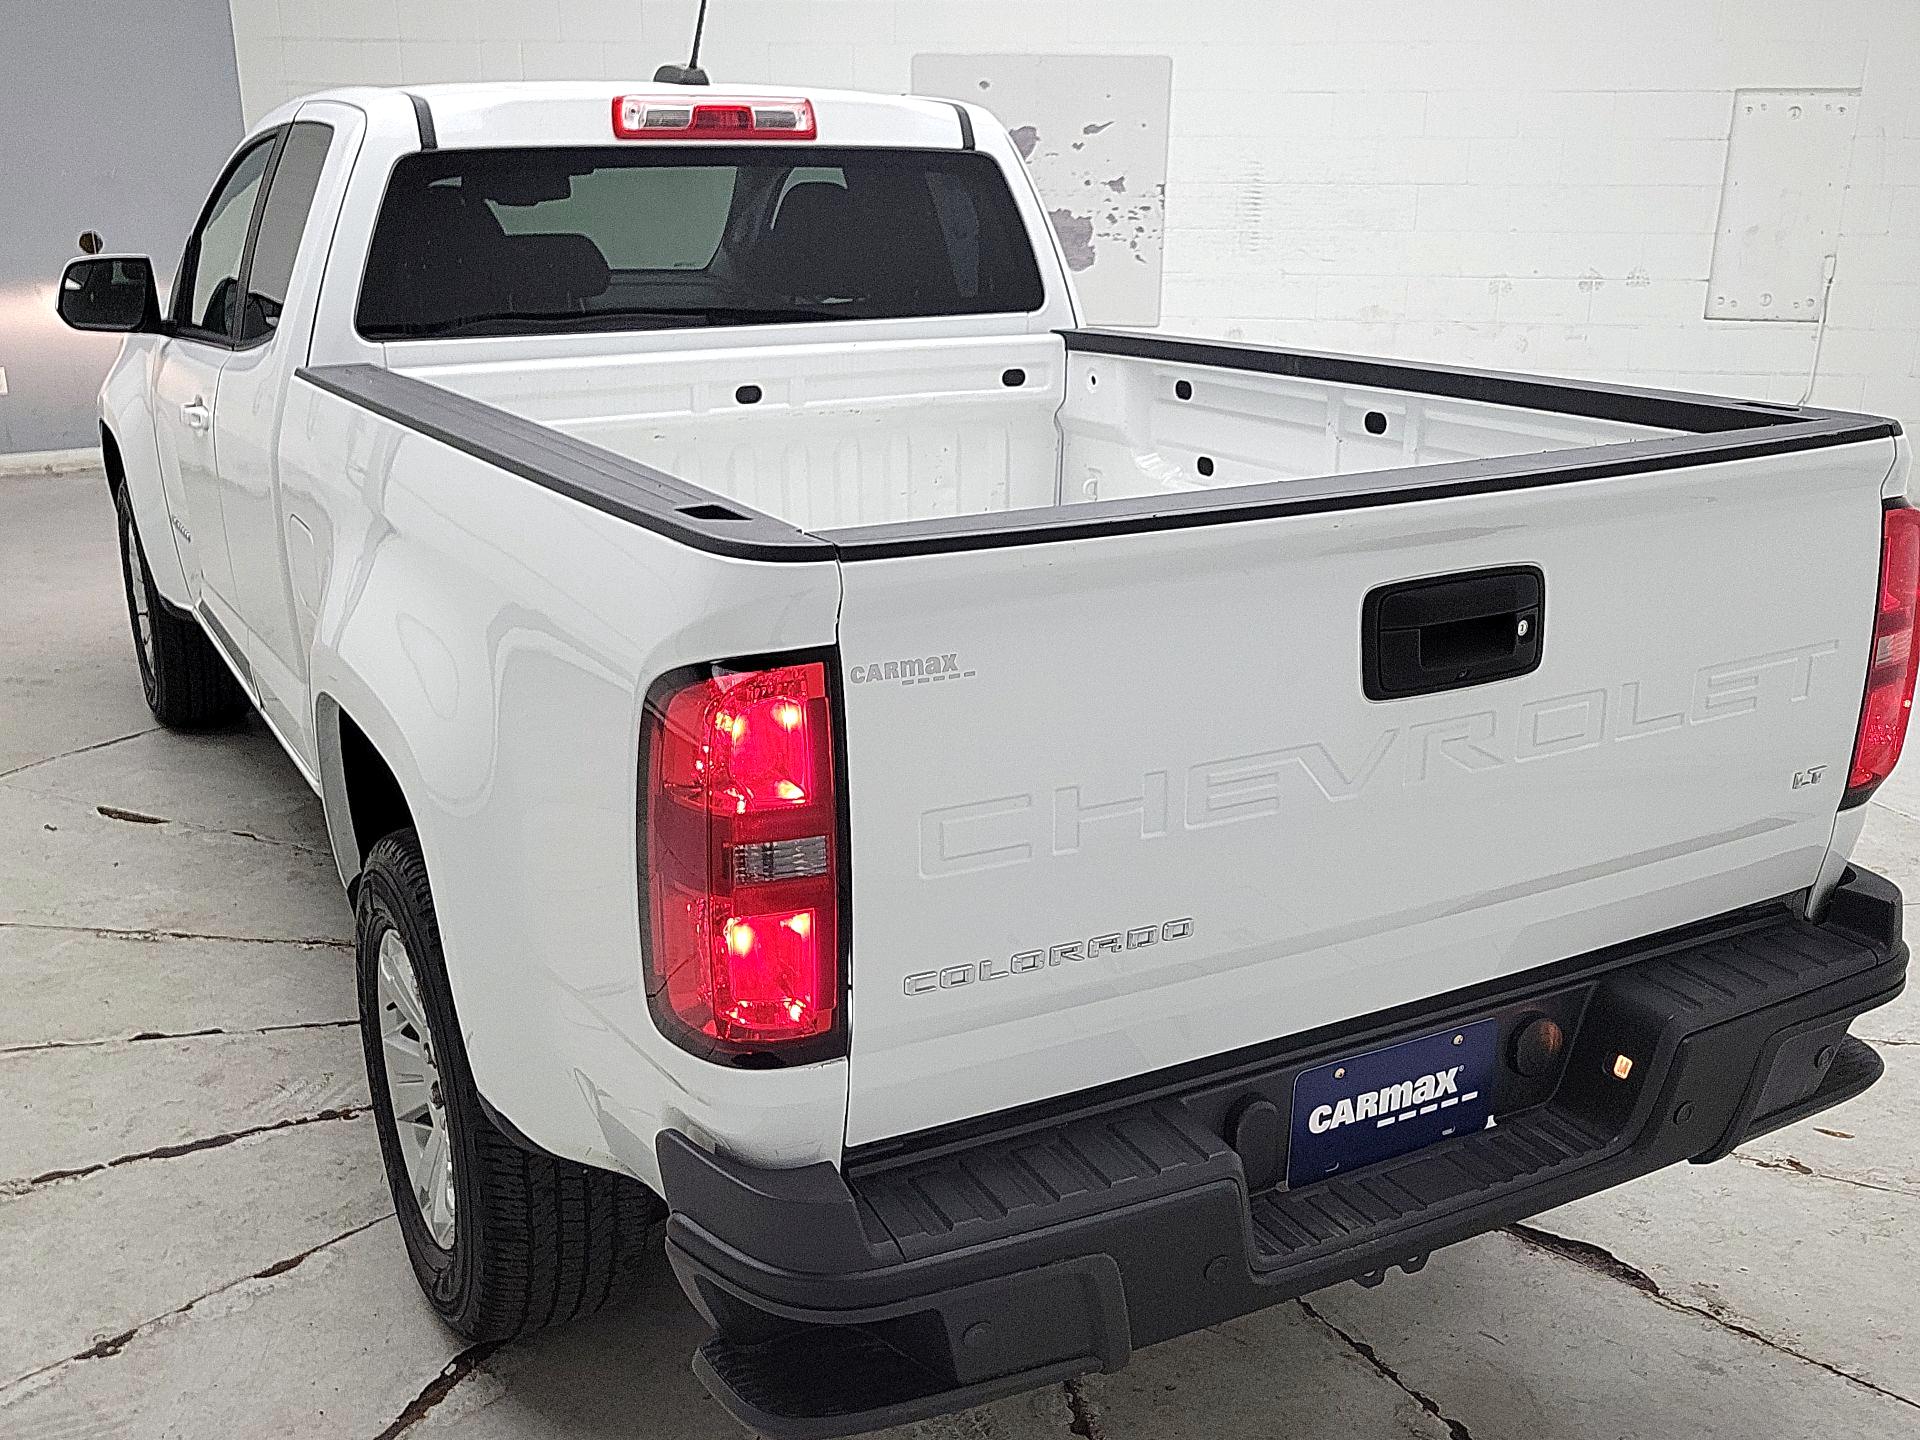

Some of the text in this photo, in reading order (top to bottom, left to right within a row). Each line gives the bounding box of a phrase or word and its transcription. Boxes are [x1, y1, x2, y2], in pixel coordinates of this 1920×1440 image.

[918, 638, 1840, 881] CHEVROLET
[1791, 764, 1829, 791] LT
[903, 917, 1196, 996] COLORADO
